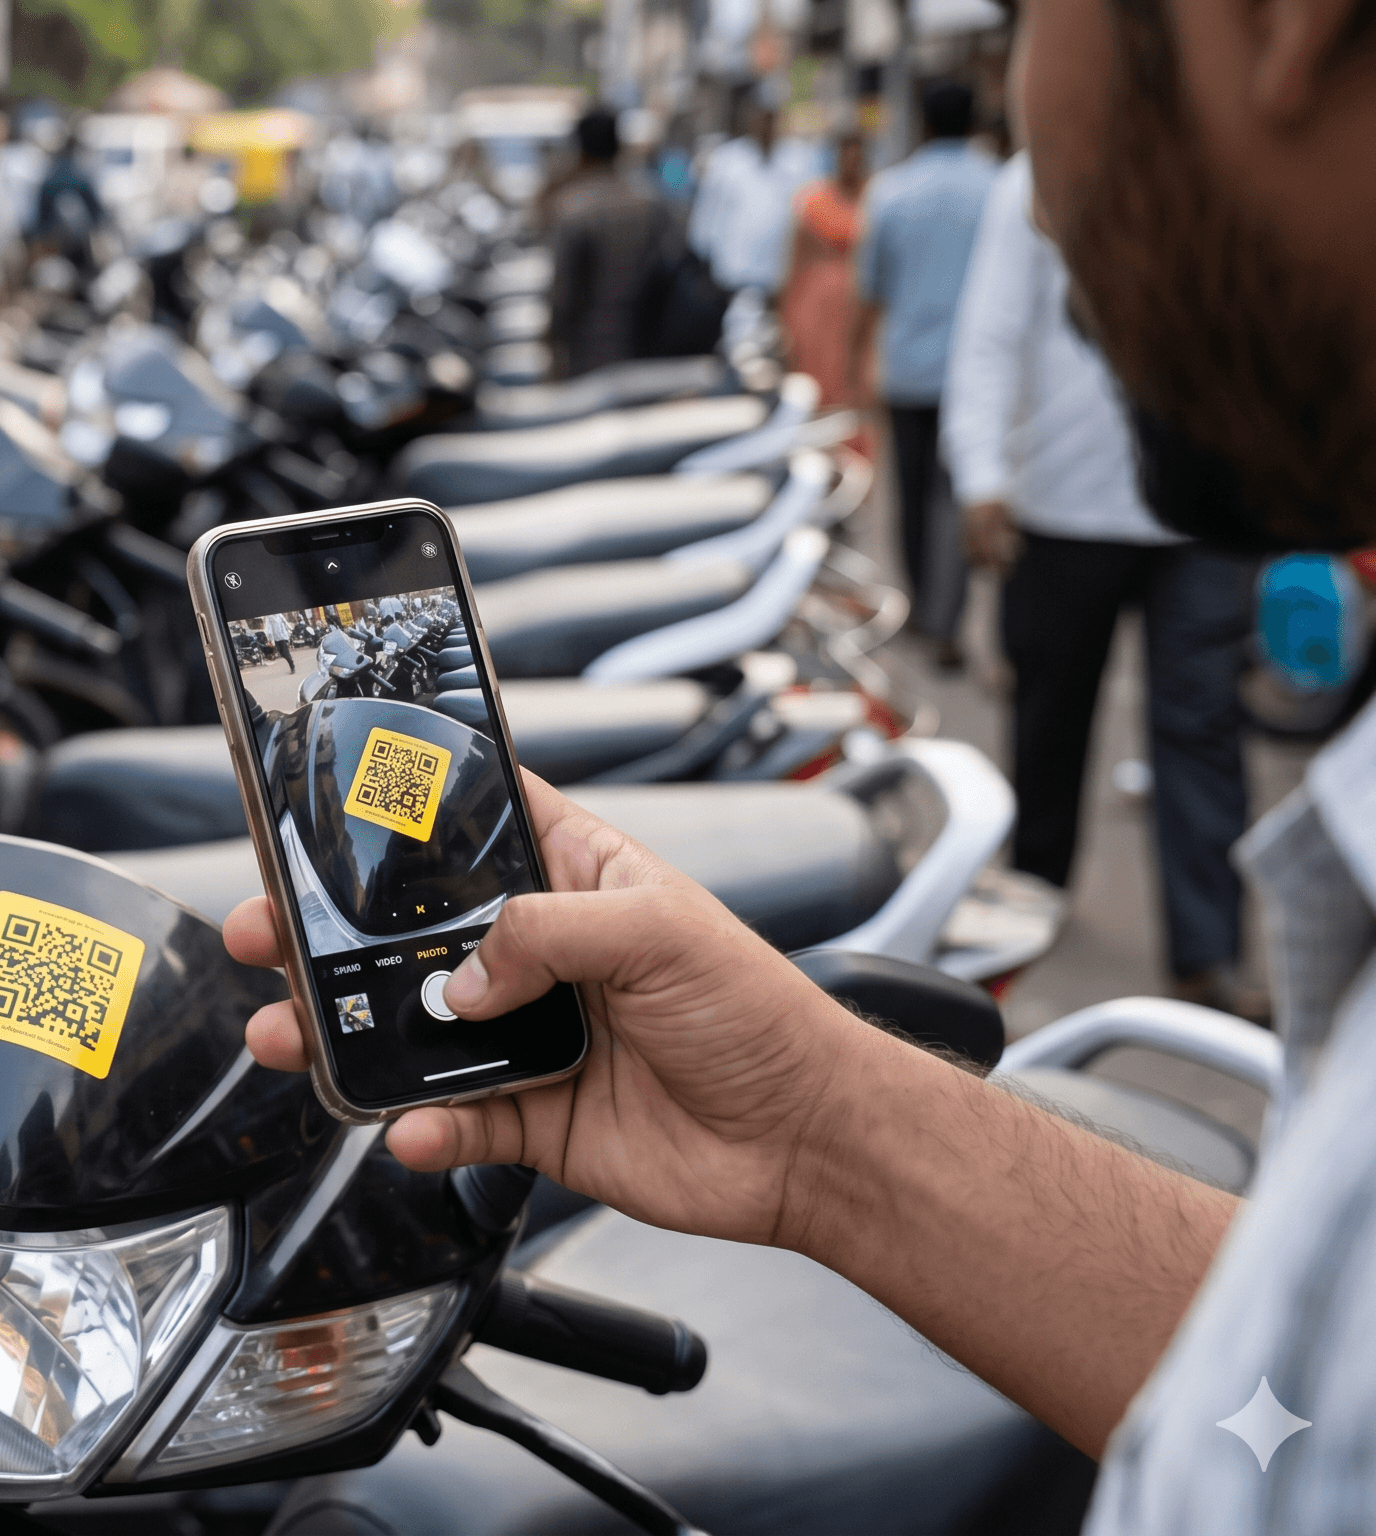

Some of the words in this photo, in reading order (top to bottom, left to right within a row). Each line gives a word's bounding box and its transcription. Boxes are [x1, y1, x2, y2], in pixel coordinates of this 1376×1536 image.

[375, 955, 402, 967] VIDEO
[417, 946, 447, 959] PHOTO
[461, 940, 481, 950] SBO
